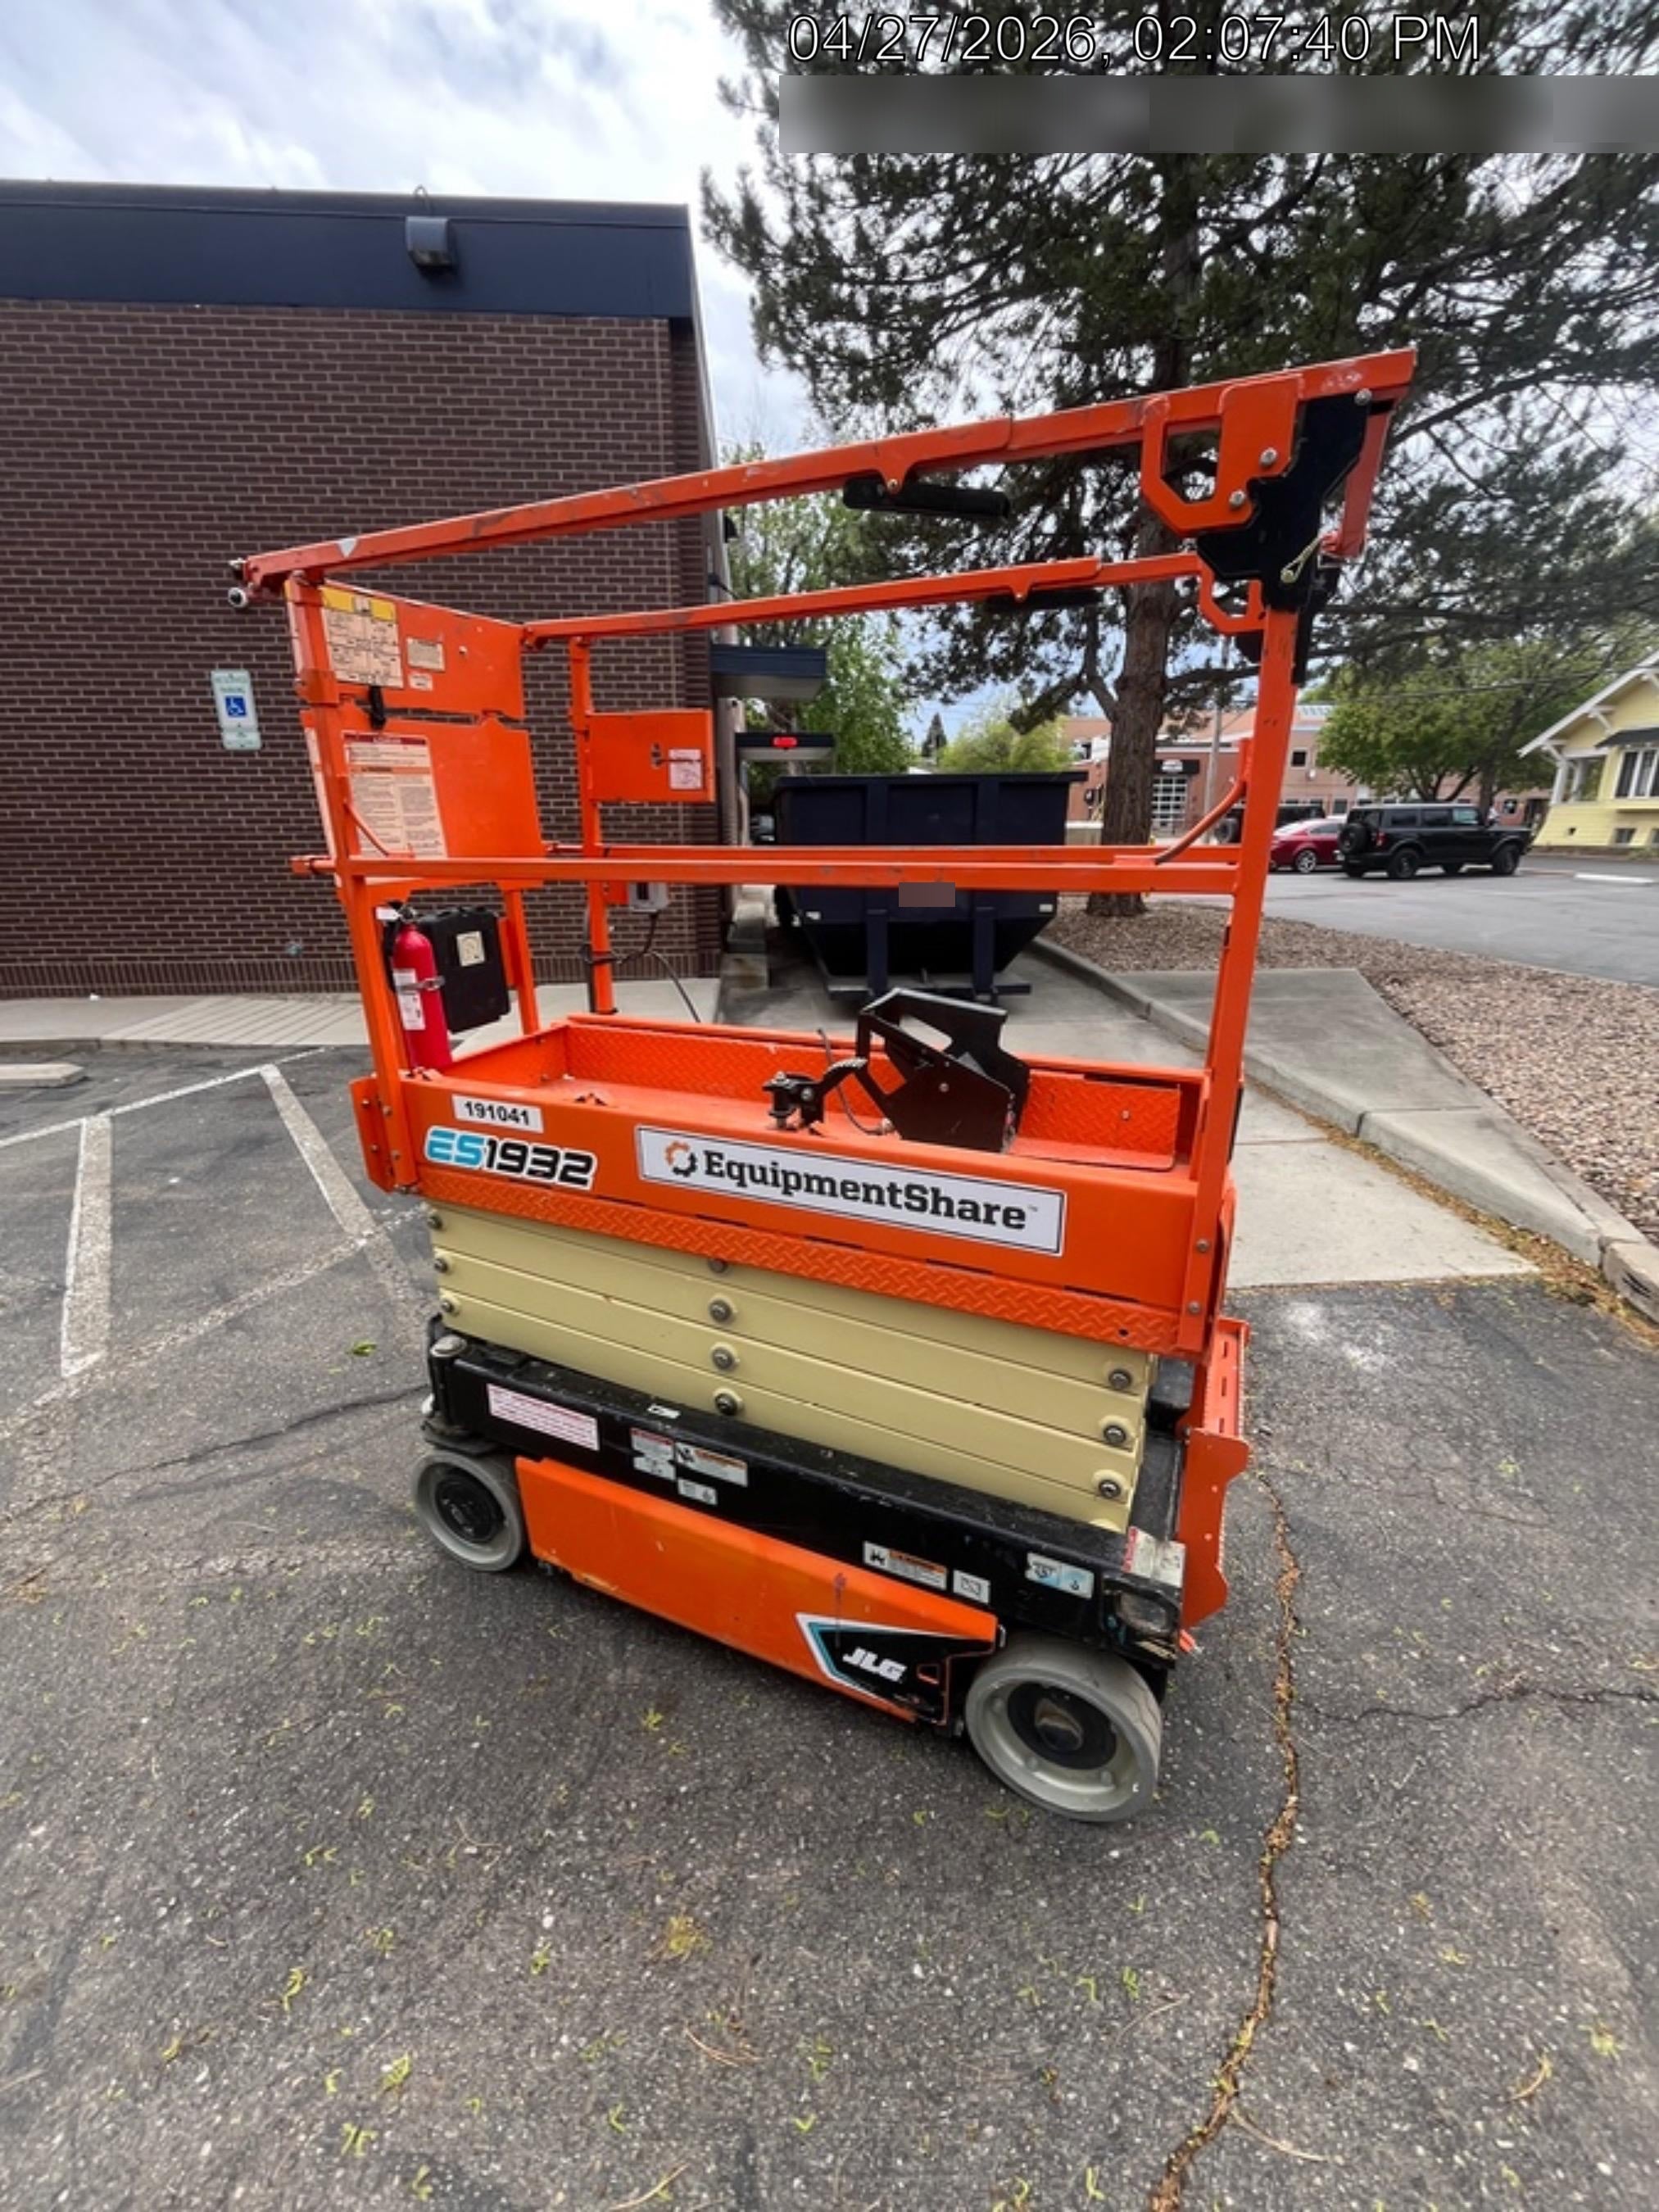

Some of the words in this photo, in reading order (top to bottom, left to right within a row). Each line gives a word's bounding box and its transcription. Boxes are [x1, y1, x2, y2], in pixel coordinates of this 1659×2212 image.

[465, 1100, 529, 1126] 191041
[427, 1128, 595, 1187] ES1932
[703, 1149, 1027, 1231] EquipmentShare
[841, 1646, 908, 1684] JLG
